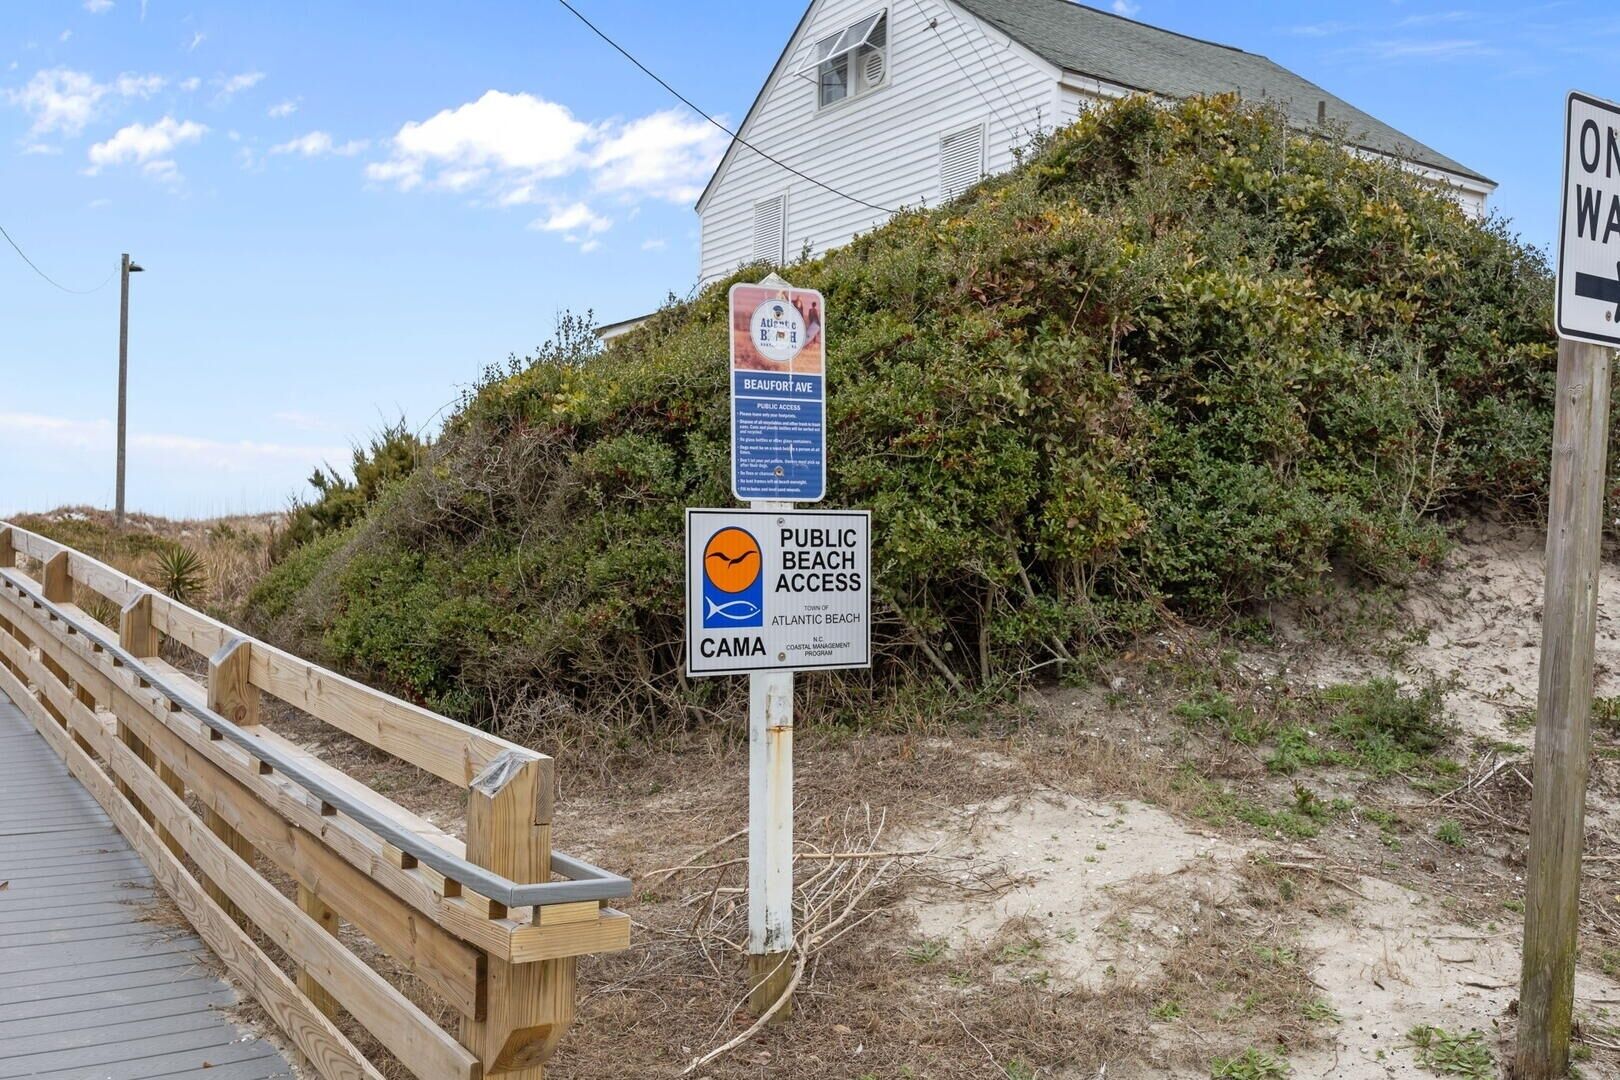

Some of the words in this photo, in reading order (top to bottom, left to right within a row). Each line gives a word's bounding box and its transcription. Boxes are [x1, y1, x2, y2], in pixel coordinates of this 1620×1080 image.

[744, 379, 793, 391] BEAUFORT
[795, 382, 813, 392] AVE
[780, 528, 857, 548] PUBLIC
[782, 551, 855, 570] BEACH
[775, 573, 861, 592] ACCESS
[772, 614, 822, 626] ATLANTIC
[825, 613, 860, 624] BEACH
[700, 637, 766, 658] CAMA
